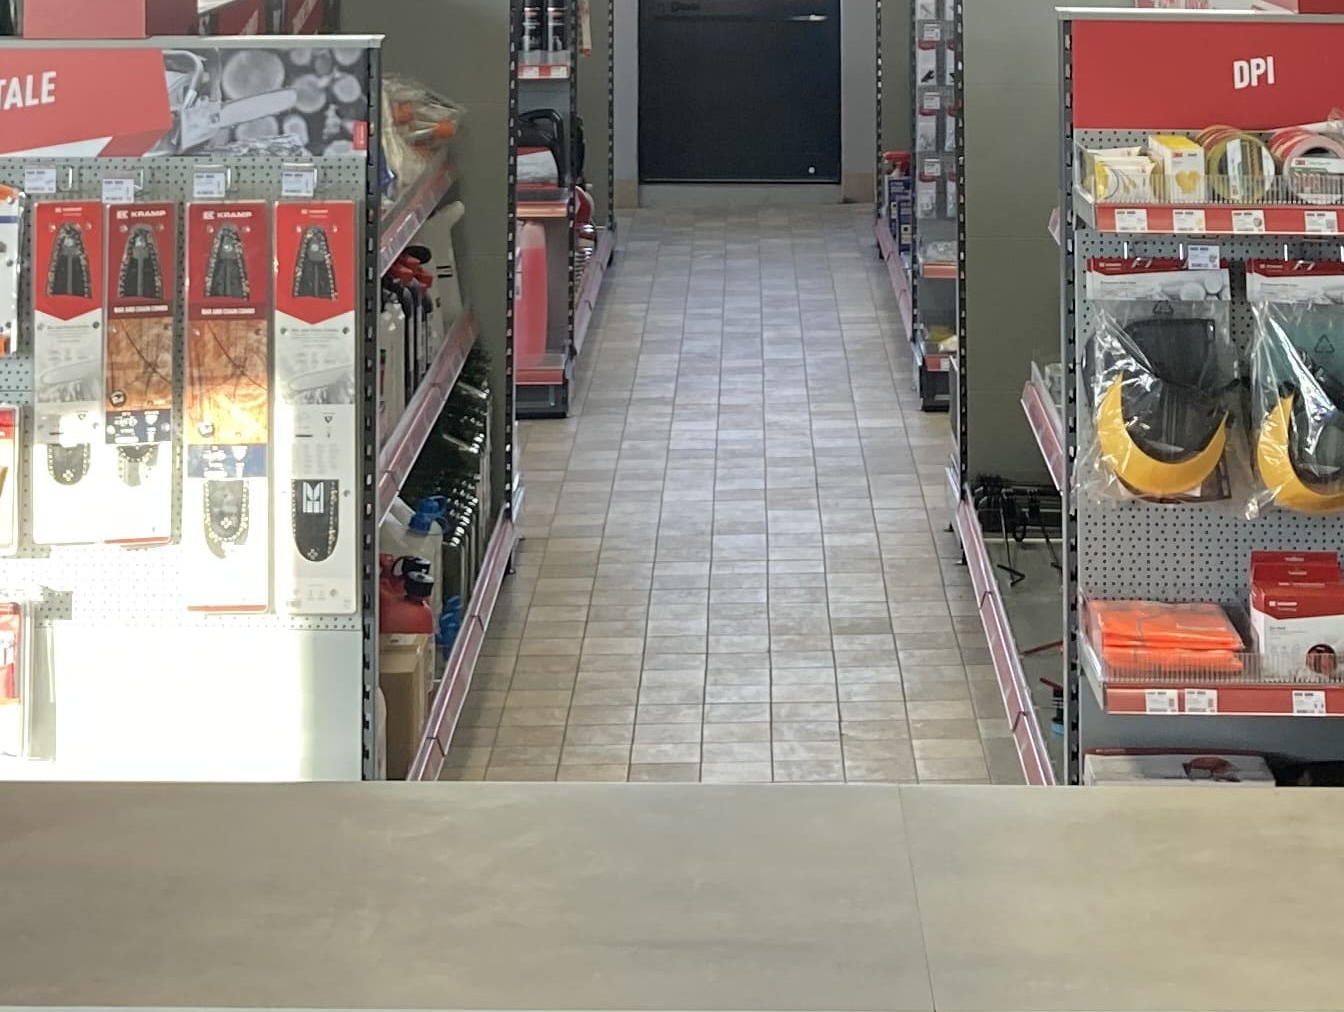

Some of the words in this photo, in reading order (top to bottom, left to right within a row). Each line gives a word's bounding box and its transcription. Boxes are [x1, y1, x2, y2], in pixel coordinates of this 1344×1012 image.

[1233, 56, 1275, 90] DPI
[131, 210, 167, 218] KRAMP
[217, 211, 252, 219] KRAMP
